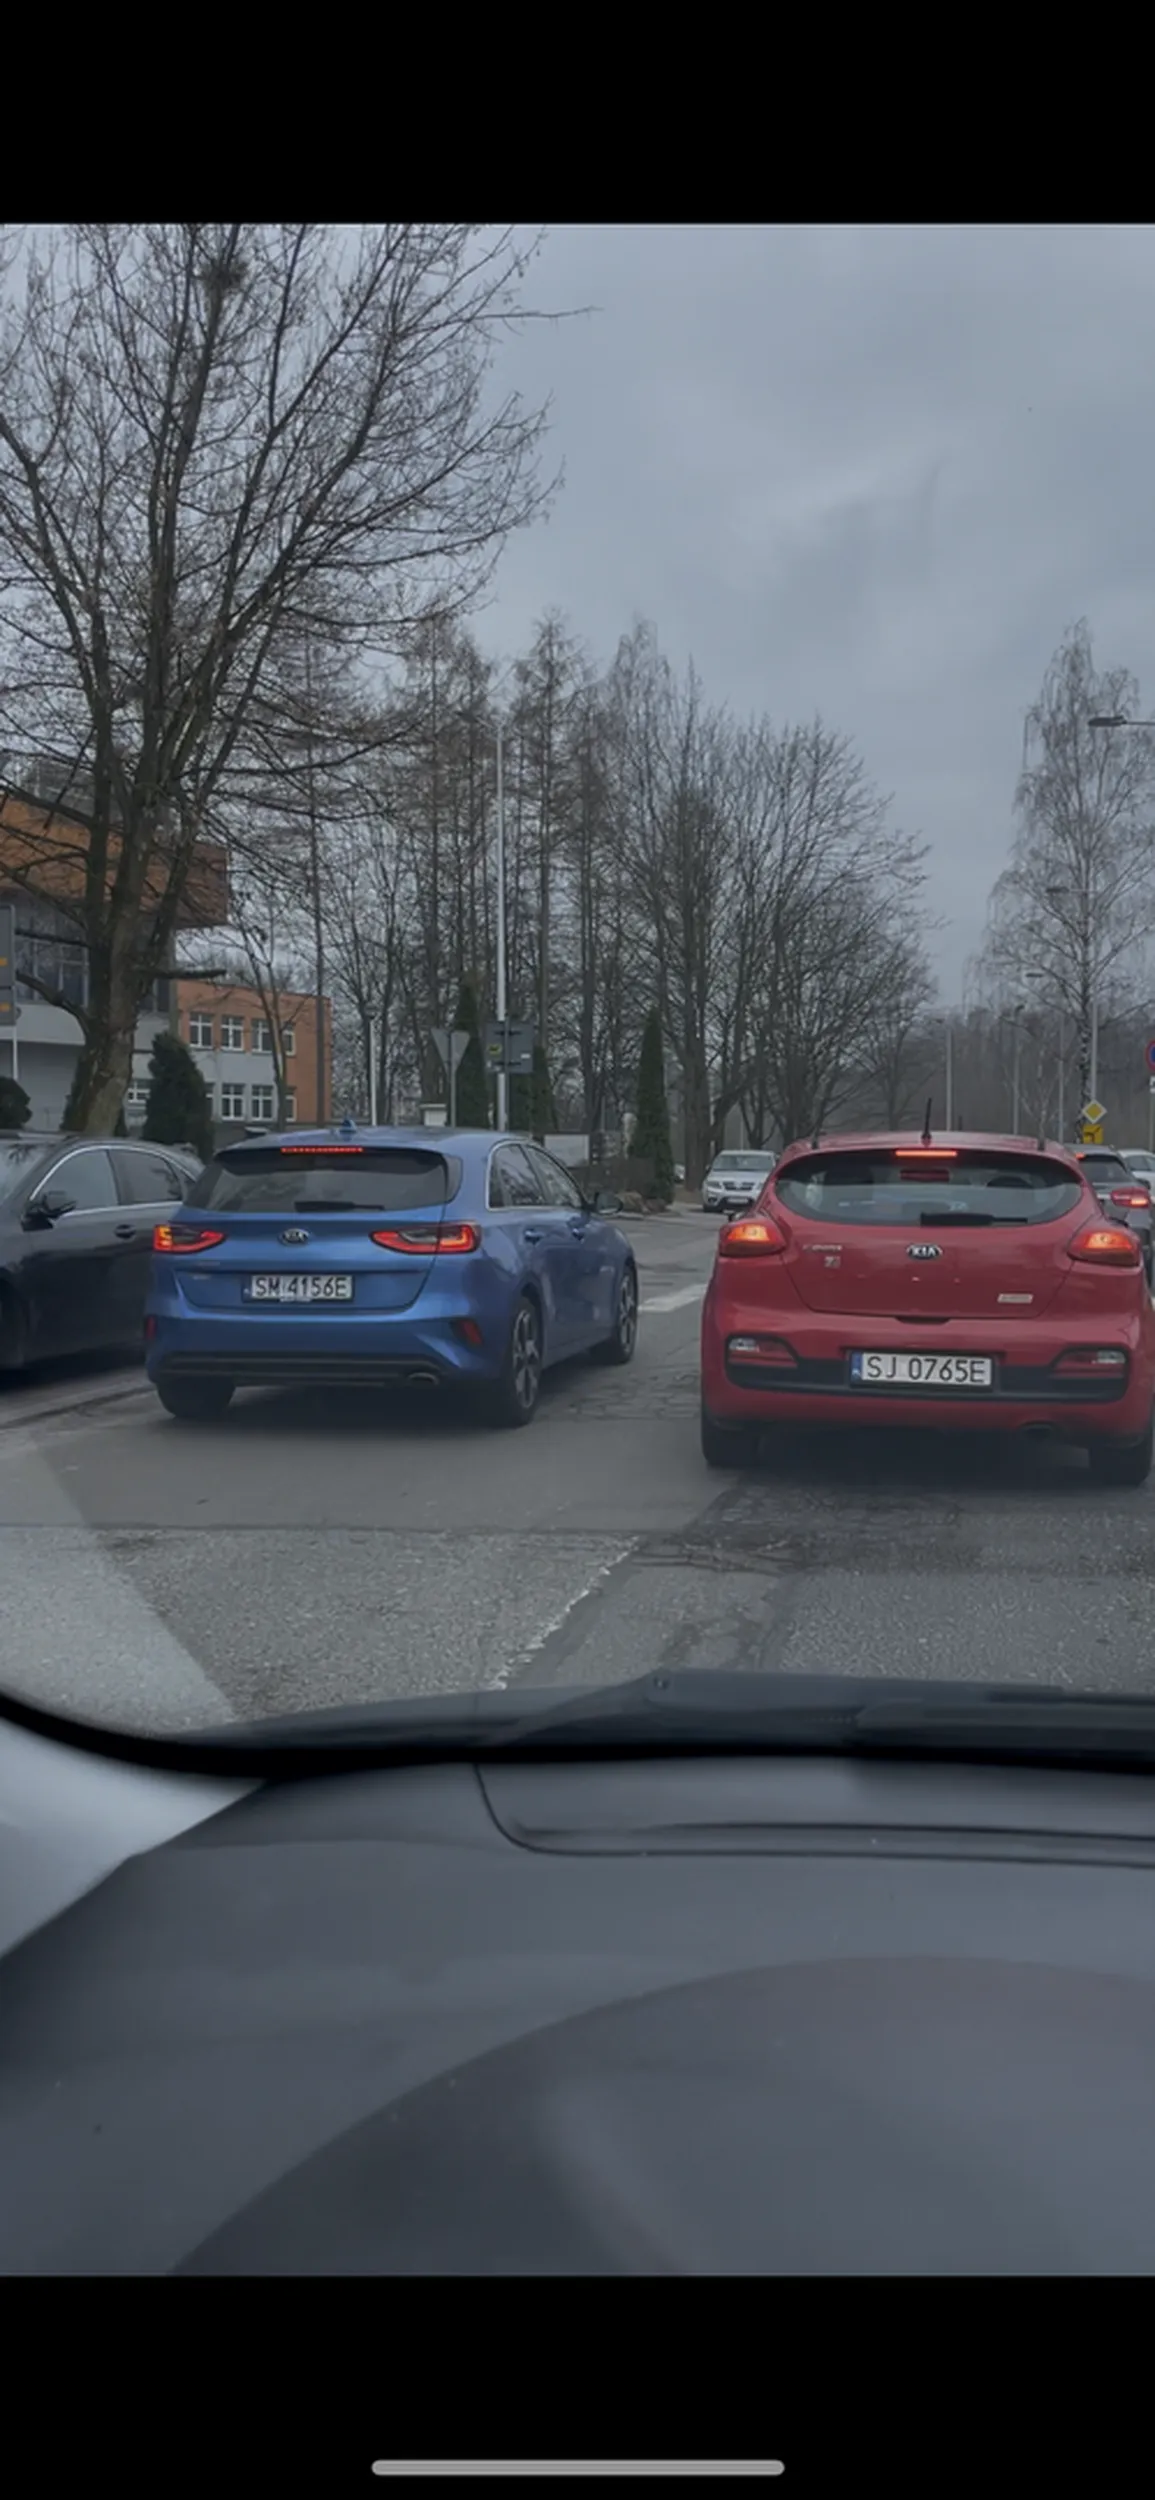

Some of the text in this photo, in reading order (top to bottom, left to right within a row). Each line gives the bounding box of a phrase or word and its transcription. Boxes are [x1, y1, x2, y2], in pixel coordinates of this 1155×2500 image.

[909, 1245, 939, 1258] KIA
[255, 1276, 348, 1297] SM 4156E
[866, 1356, 986, 1383] SJ 0765E
